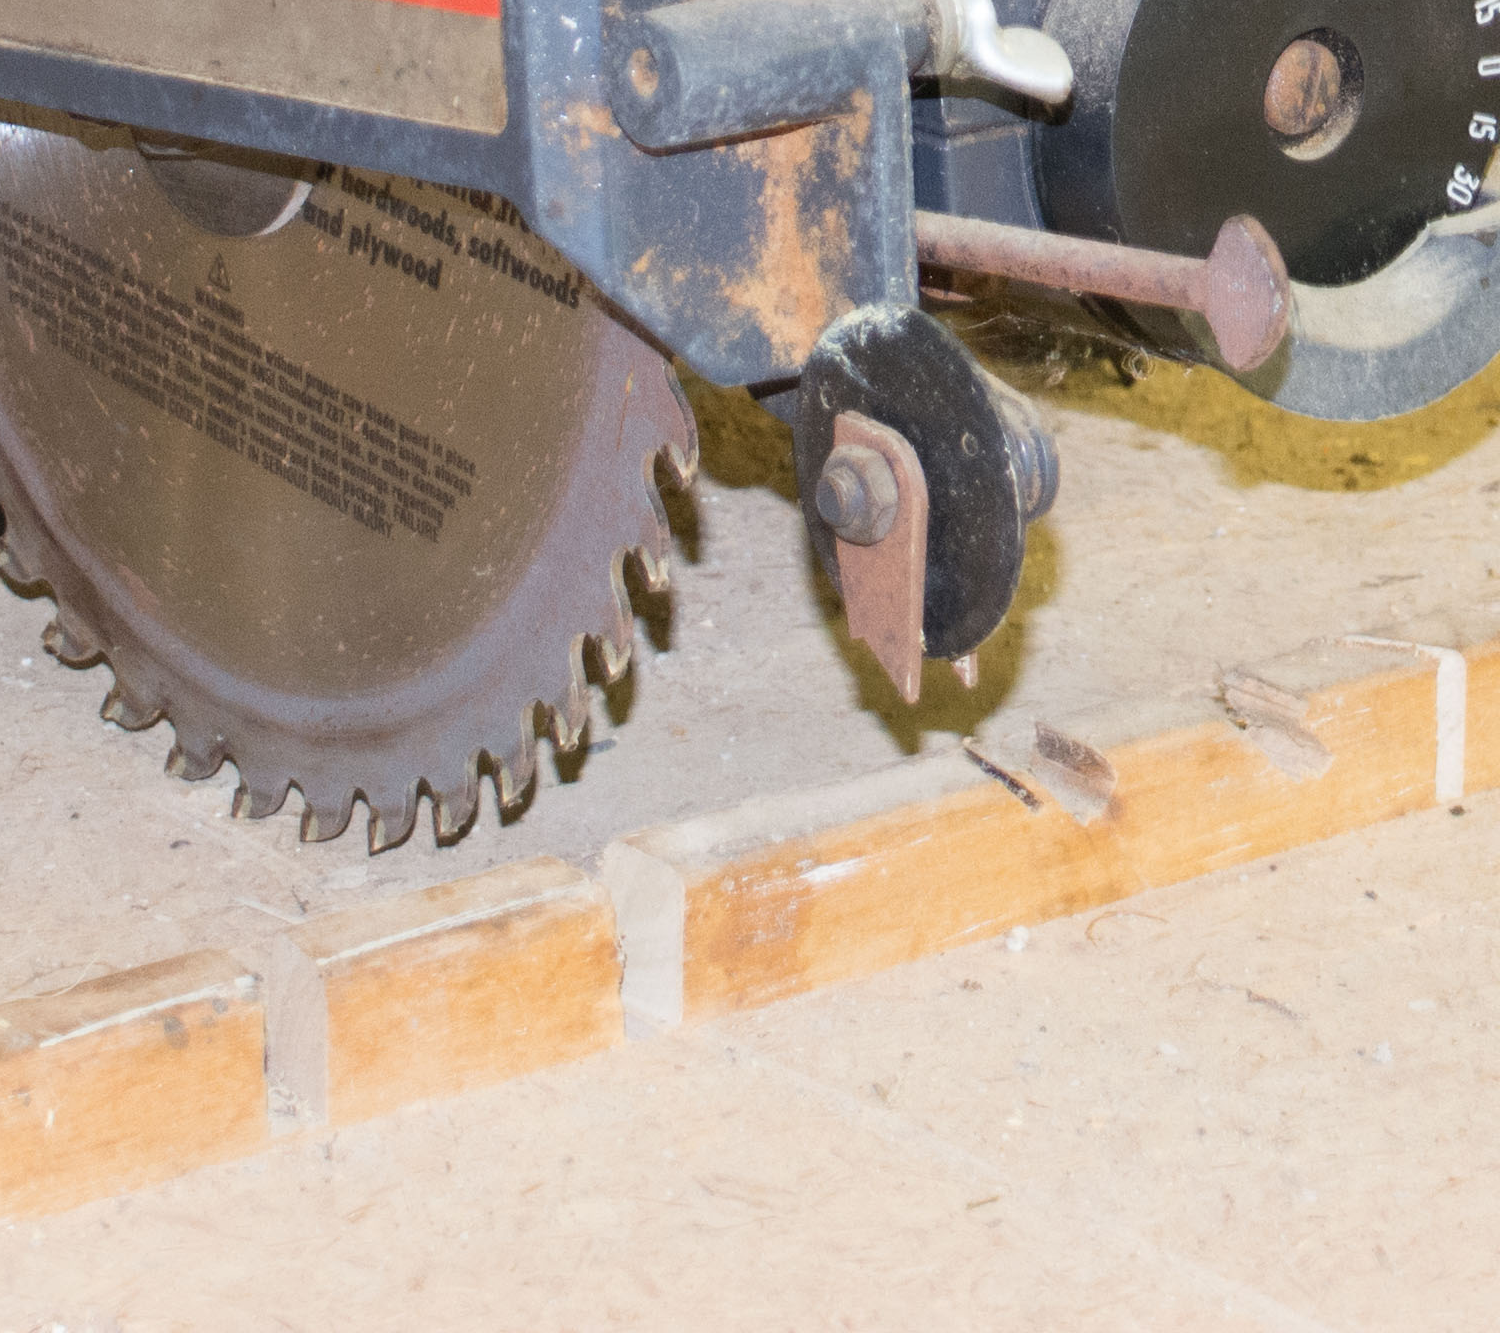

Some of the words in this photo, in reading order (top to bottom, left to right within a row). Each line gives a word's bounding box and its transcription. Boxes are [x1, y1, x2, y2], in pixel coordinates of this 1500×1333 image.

[1468, 111, 1498, 142] 15
[1446, 162, 1481, 207] 30
[302, 200, 345, 240] and
[348, 221, 444, 293] plywood
[341, 164, 463, 257] hardwoods,
[467, 235, 582, 310] softwoods
